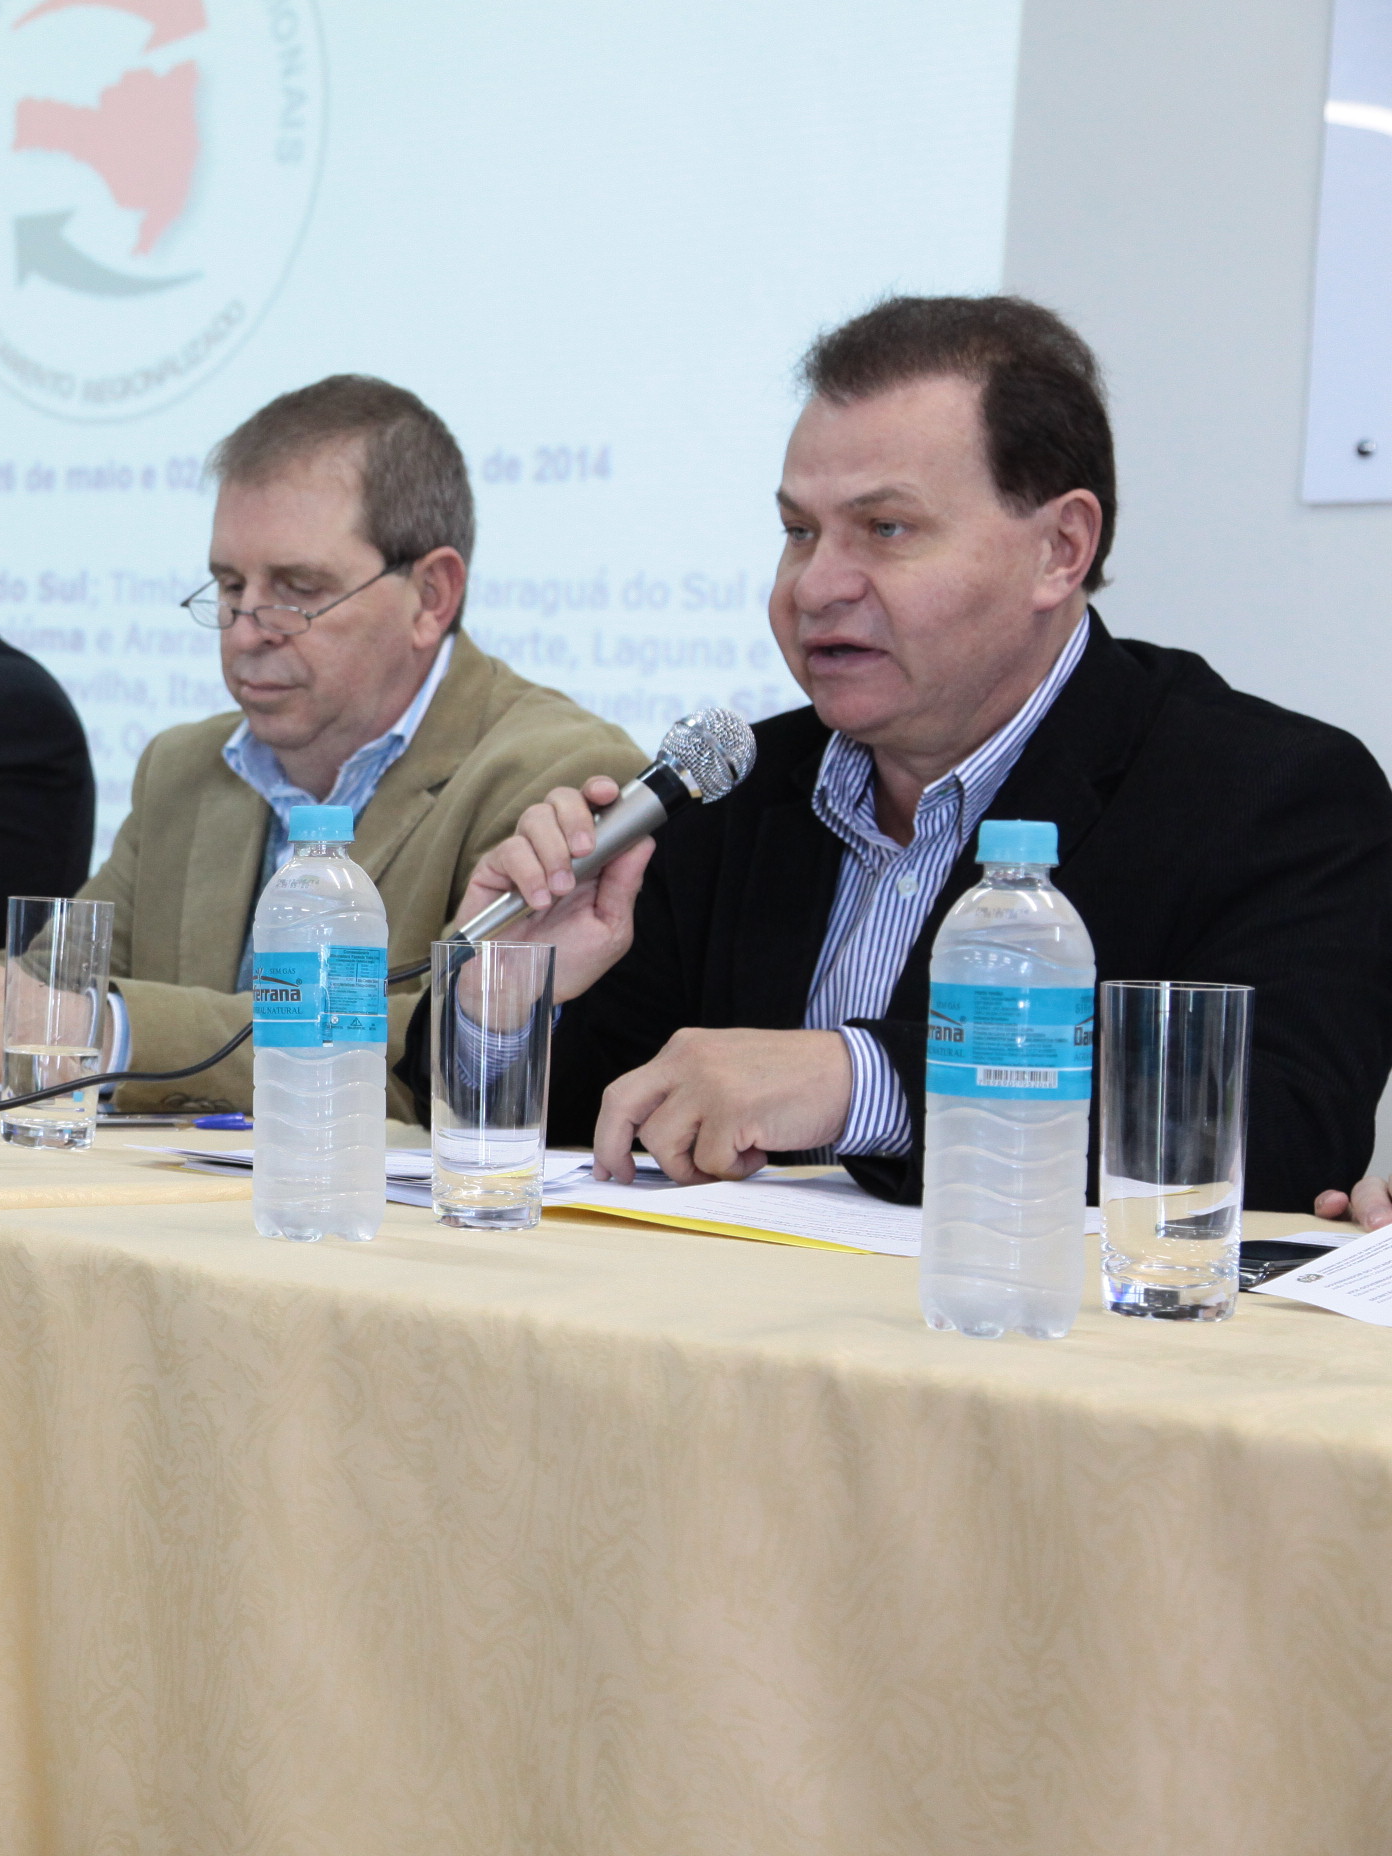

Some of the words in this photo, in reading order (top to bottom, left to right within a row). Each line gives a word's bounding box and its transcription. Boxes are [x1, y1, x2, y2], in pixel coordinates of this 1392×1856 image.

[25, 460, 56, 493] de
[64, 460, 133, 493] maio
[140, 465, 156, 492] e
[482, 449, 522, 484] de
[533, 444, 612, 484] 2014
[621, 569, 671, 611] do
[681, 570, 748, 612] Sul
[94, 627, 113, 654] e
[592, 627, 738, 677] Laguna
[745, 637, 774, 671] e
[266, 1007, 303, 1015] NATURAL
